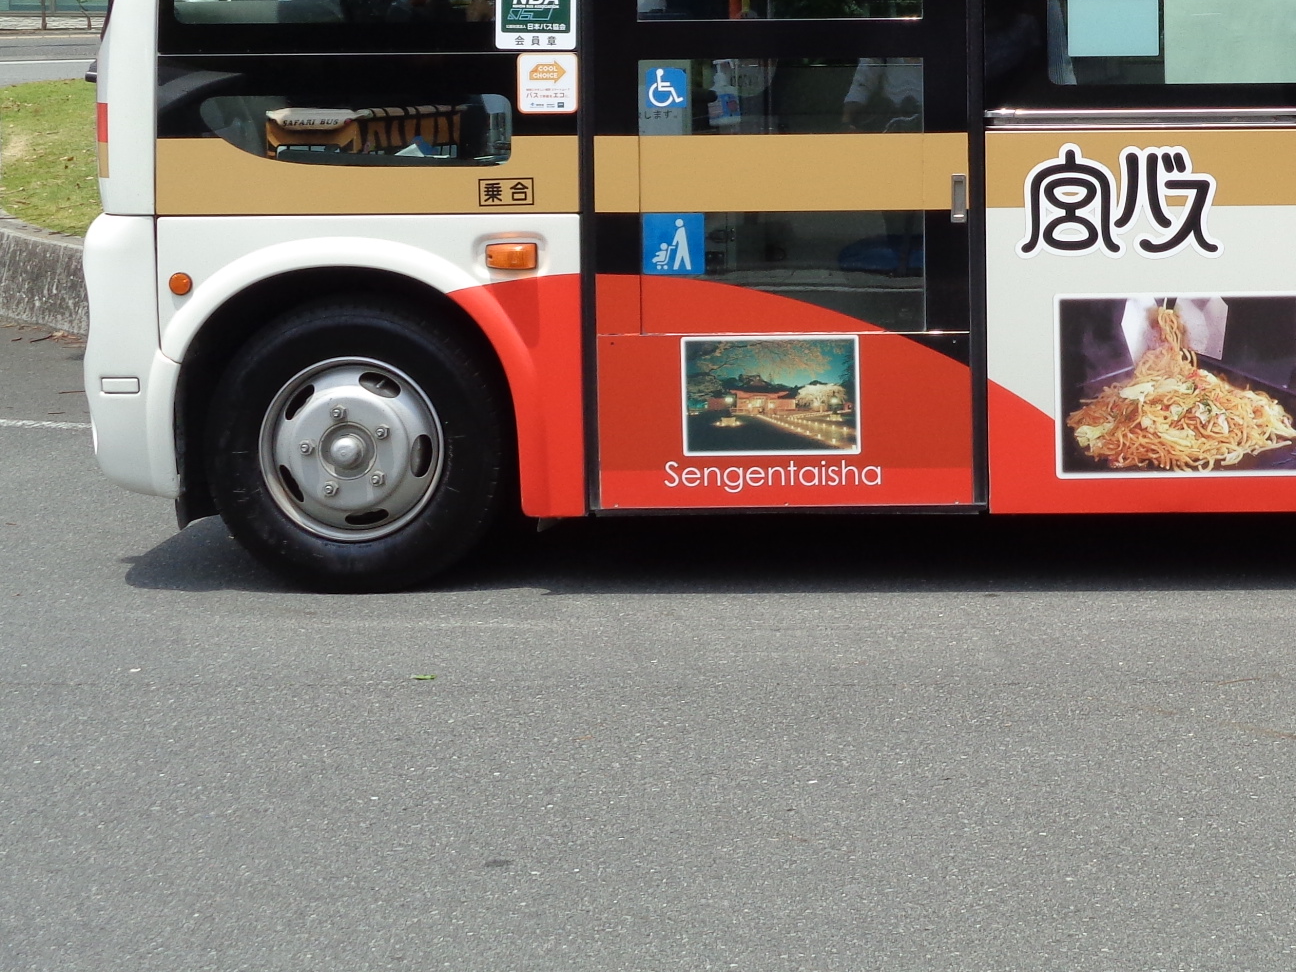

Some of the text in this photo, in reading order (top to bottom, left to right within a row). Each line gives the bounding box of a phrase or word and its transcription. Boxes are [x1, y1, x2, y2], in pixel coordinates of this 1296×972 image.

[283, 118, 339, 127] SAFARI BUS
[483, 181, 530, 203] 乗合
[1018, 145, 1222, 256] 宮バス
[663, 459, 882, 493] Sengentaisha
